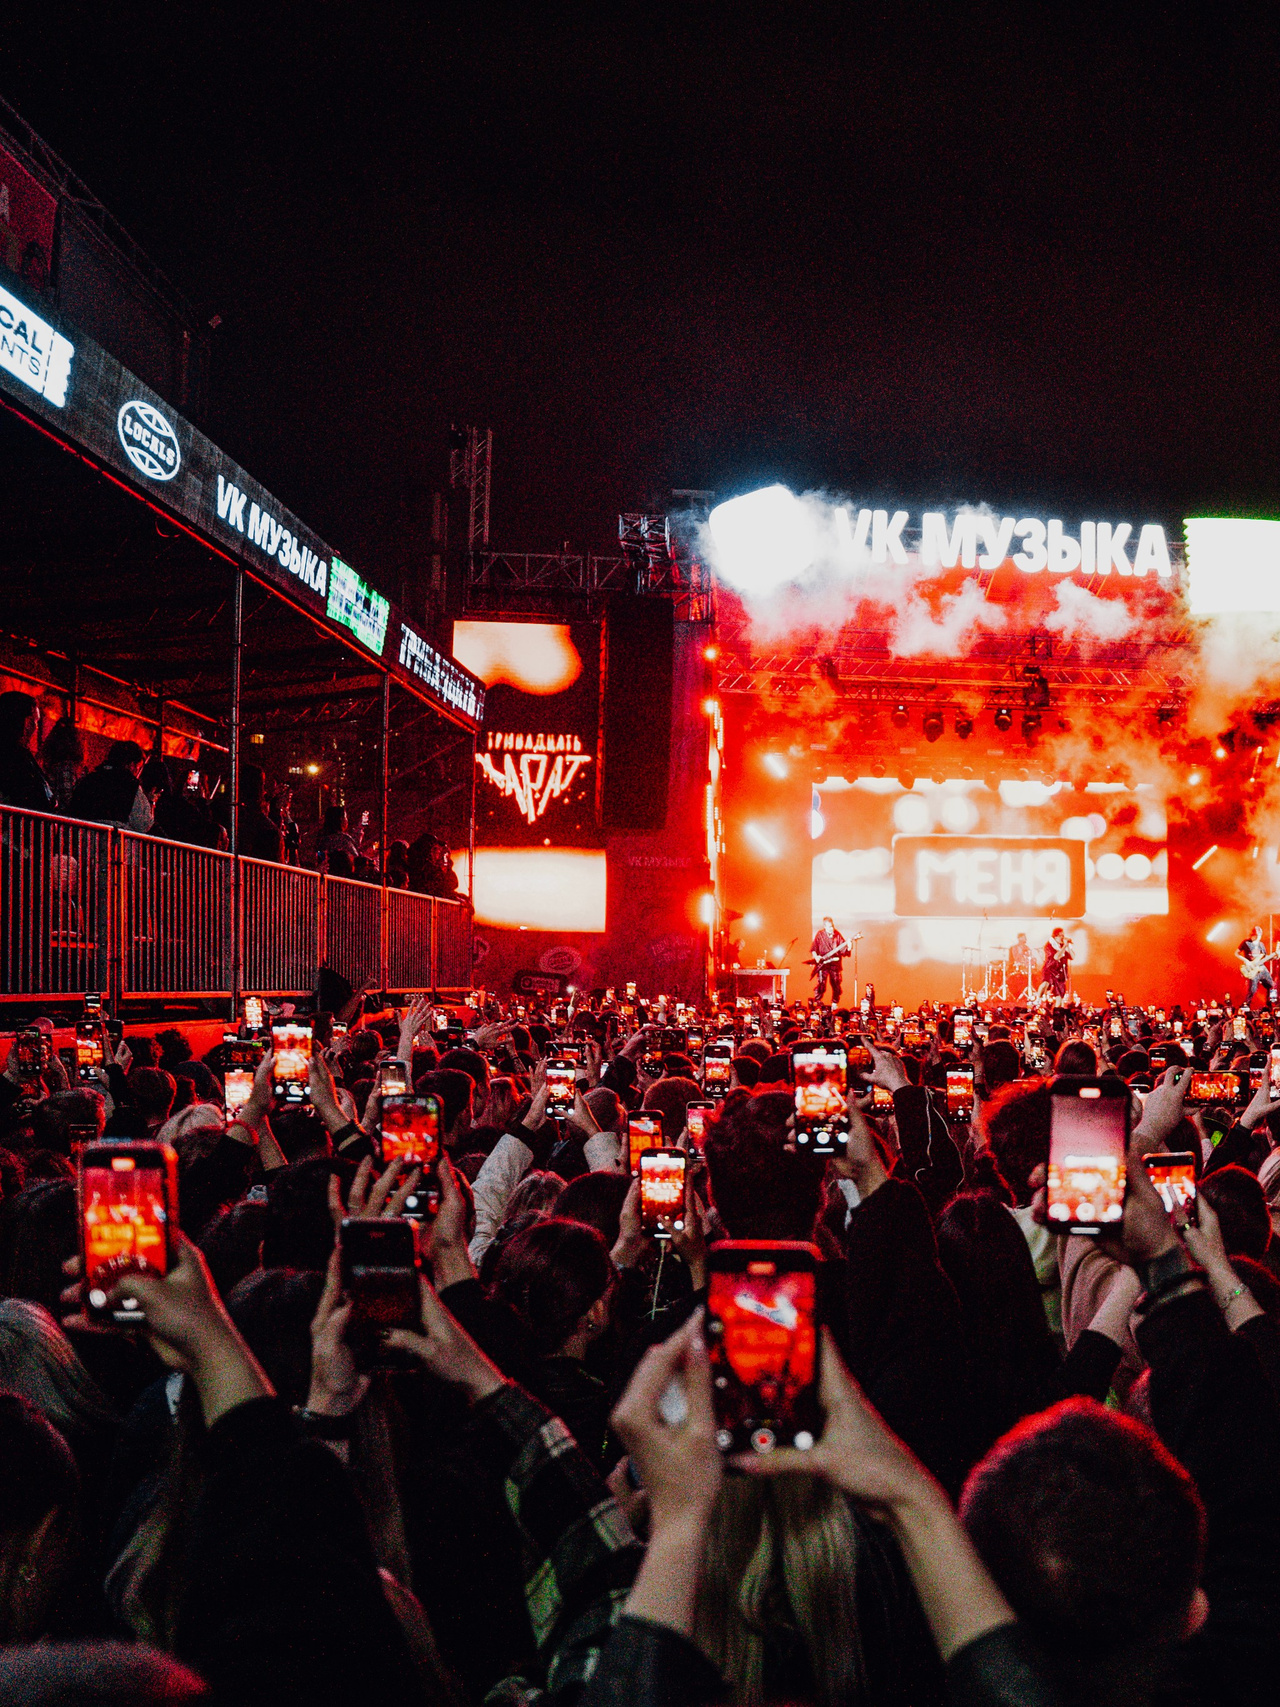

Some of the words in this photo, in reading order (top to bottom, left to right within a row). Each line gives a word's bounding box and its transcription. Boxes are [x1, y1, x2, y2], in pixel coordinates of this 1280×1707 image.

[123, 415, 176, 467] LOCALS
[217, 474, 247, 533] VK
[247, 502, 328, 598] МУЗЫКА
[834, 507, 909, 565] VK
[922, 512, 1172, 578] МУЗЫКА
[916, 849, 1070, 905] МЕНЯ
